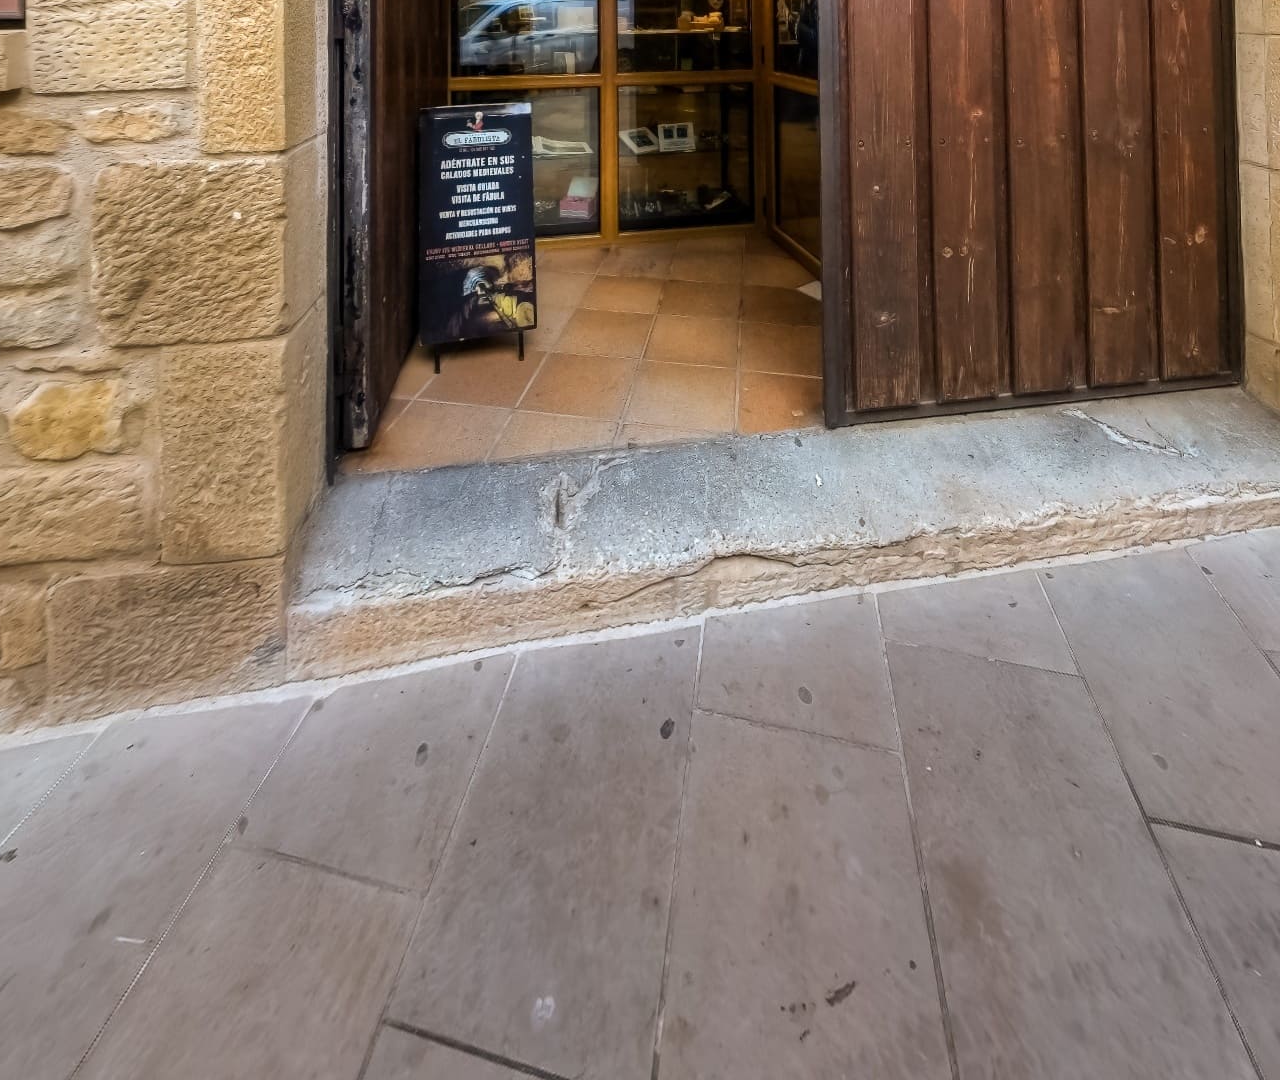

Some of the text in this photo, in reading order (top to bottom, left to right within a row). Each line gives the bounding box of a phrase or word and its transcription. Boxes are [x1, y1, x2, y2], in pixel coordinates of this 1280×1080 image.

[440, 155, 515, 170] ADÉNTRATE EN SUS
[440, 166, 514, 180] CALADOS MEDIEVALES
[456, 181, 500, 194] VISITA GUIADA
[451, 194, 472, 205] VISITA
[472, 193, 481, 202] DE
